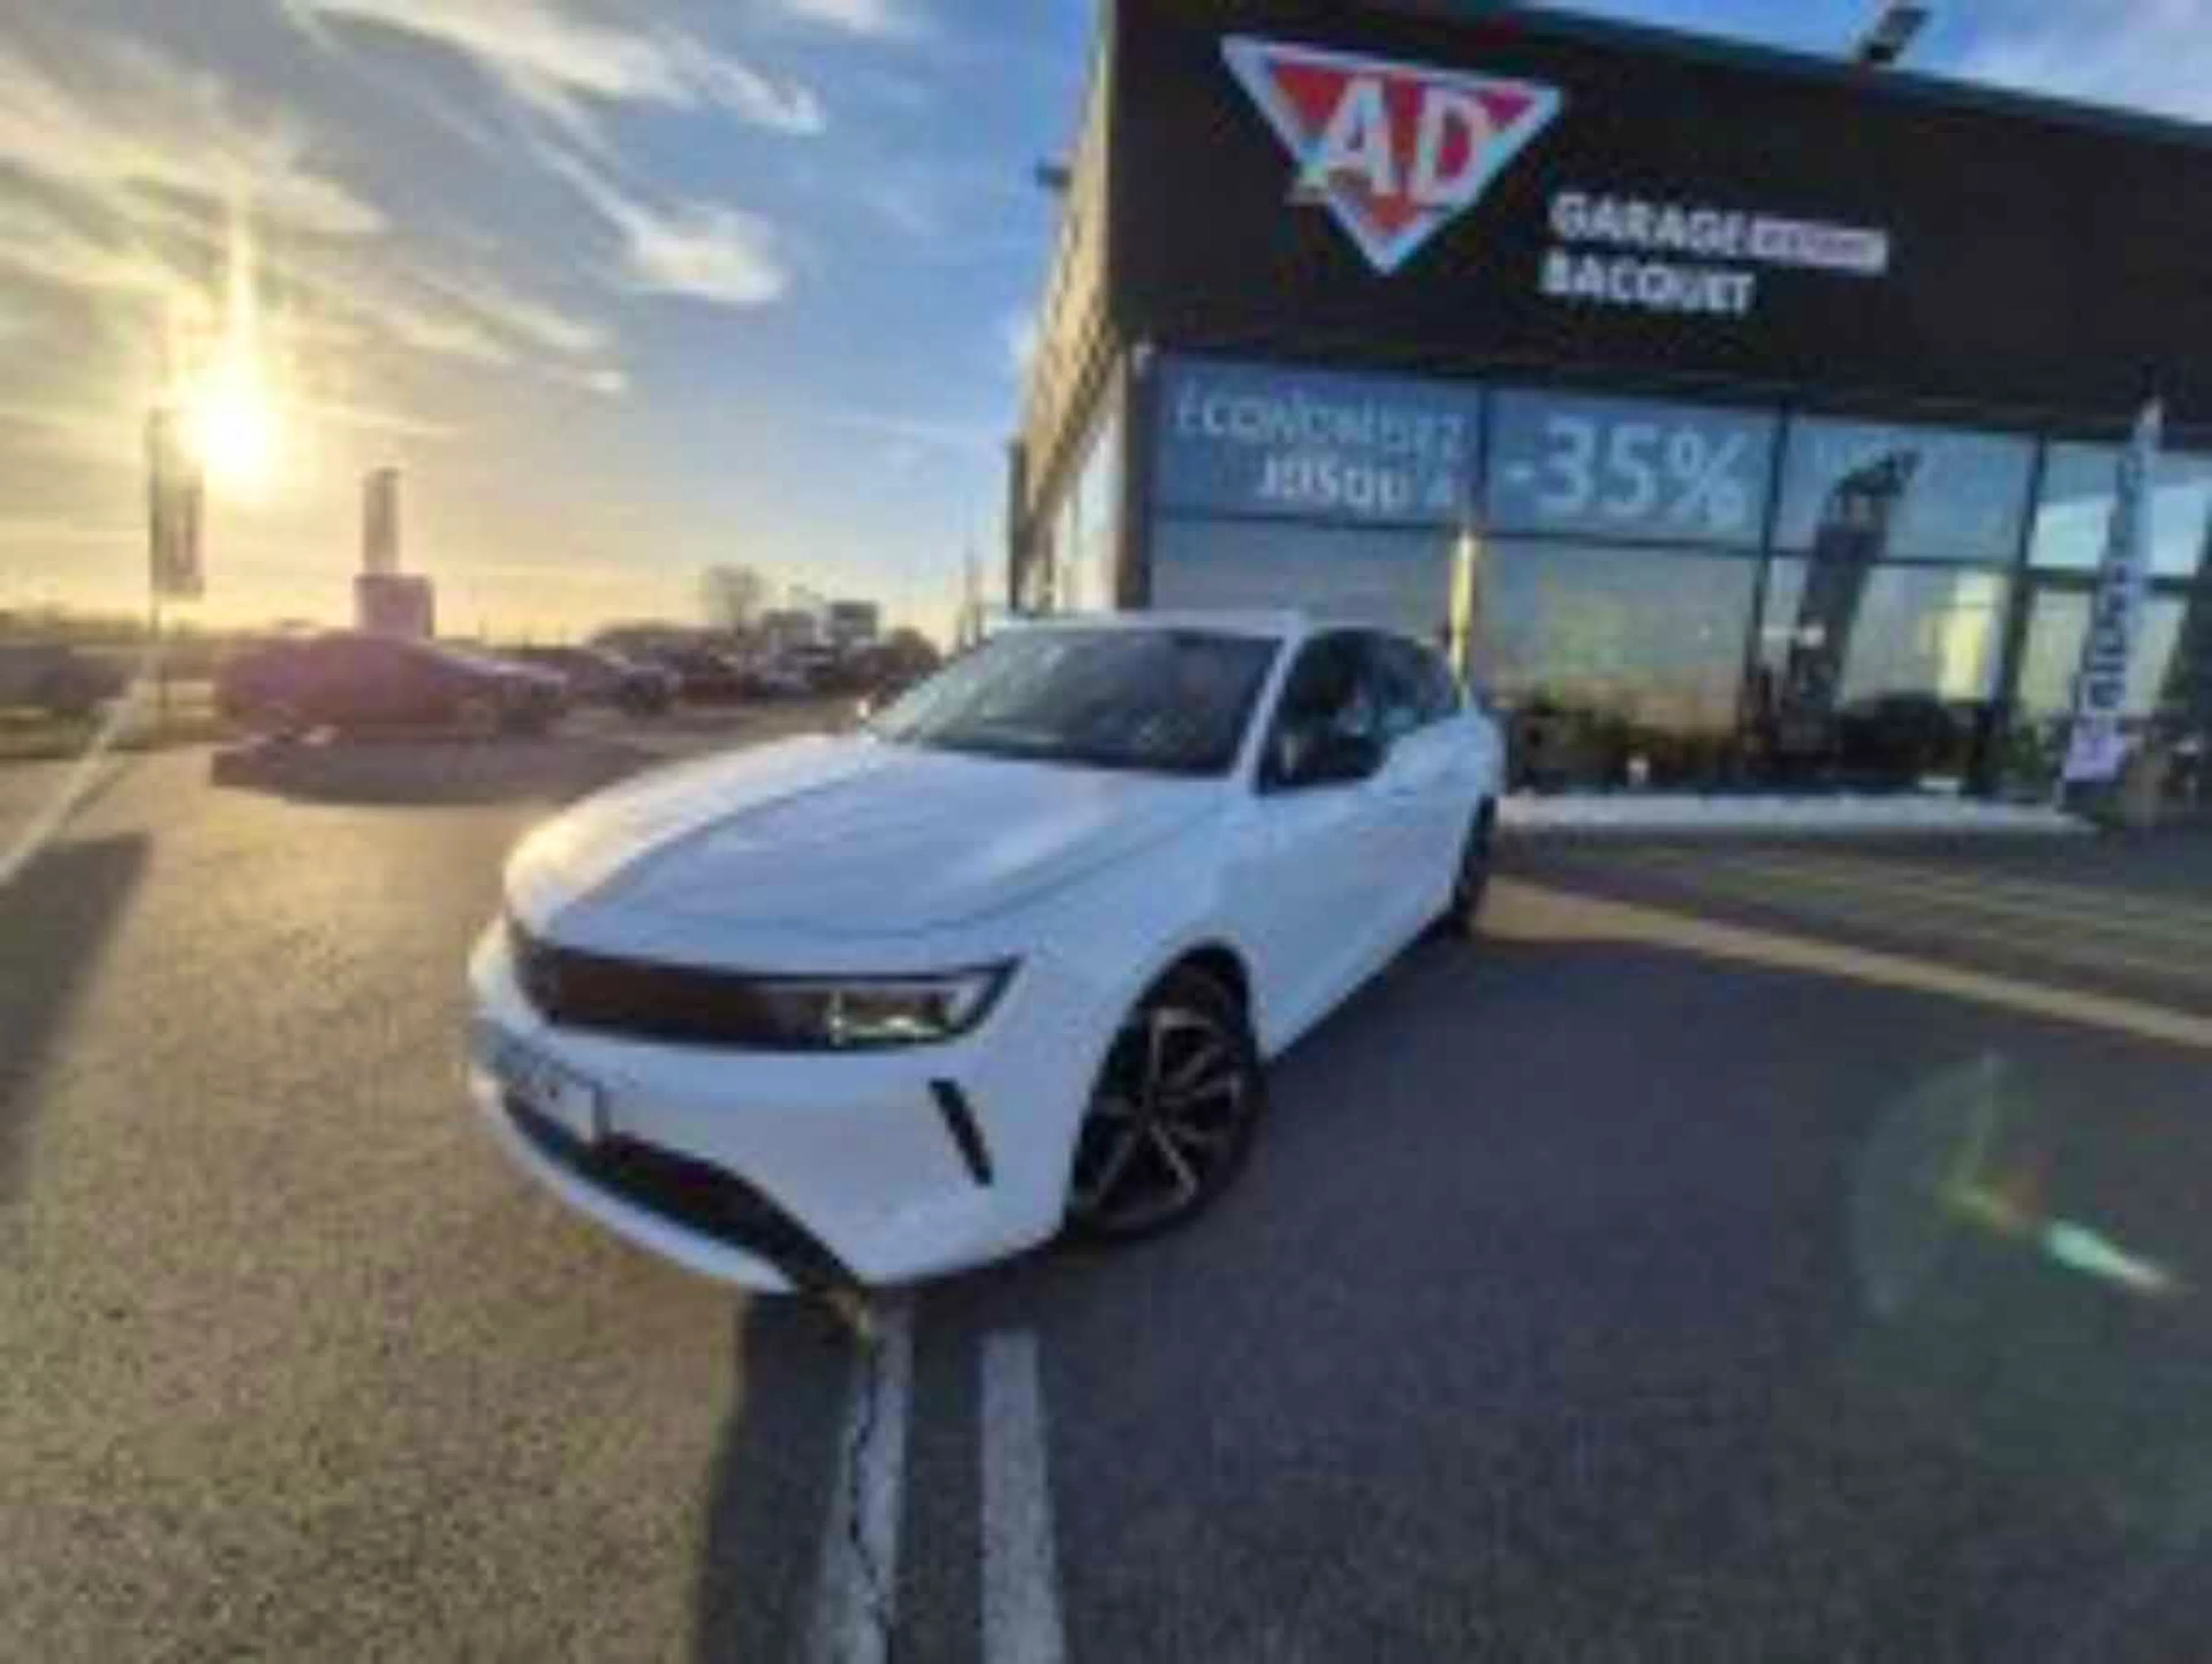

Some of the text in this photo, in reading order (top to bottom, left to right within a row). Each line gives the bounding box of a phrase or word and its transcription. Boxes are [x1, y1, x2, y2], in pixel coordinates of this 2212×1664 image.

[1286, 70, 1499, 206] AD
[1551, 191, 1748, 258] GARAGE
[1538, 248, 1756, 313] BACQUET
[1505, 412, 1750, 529] -35%
